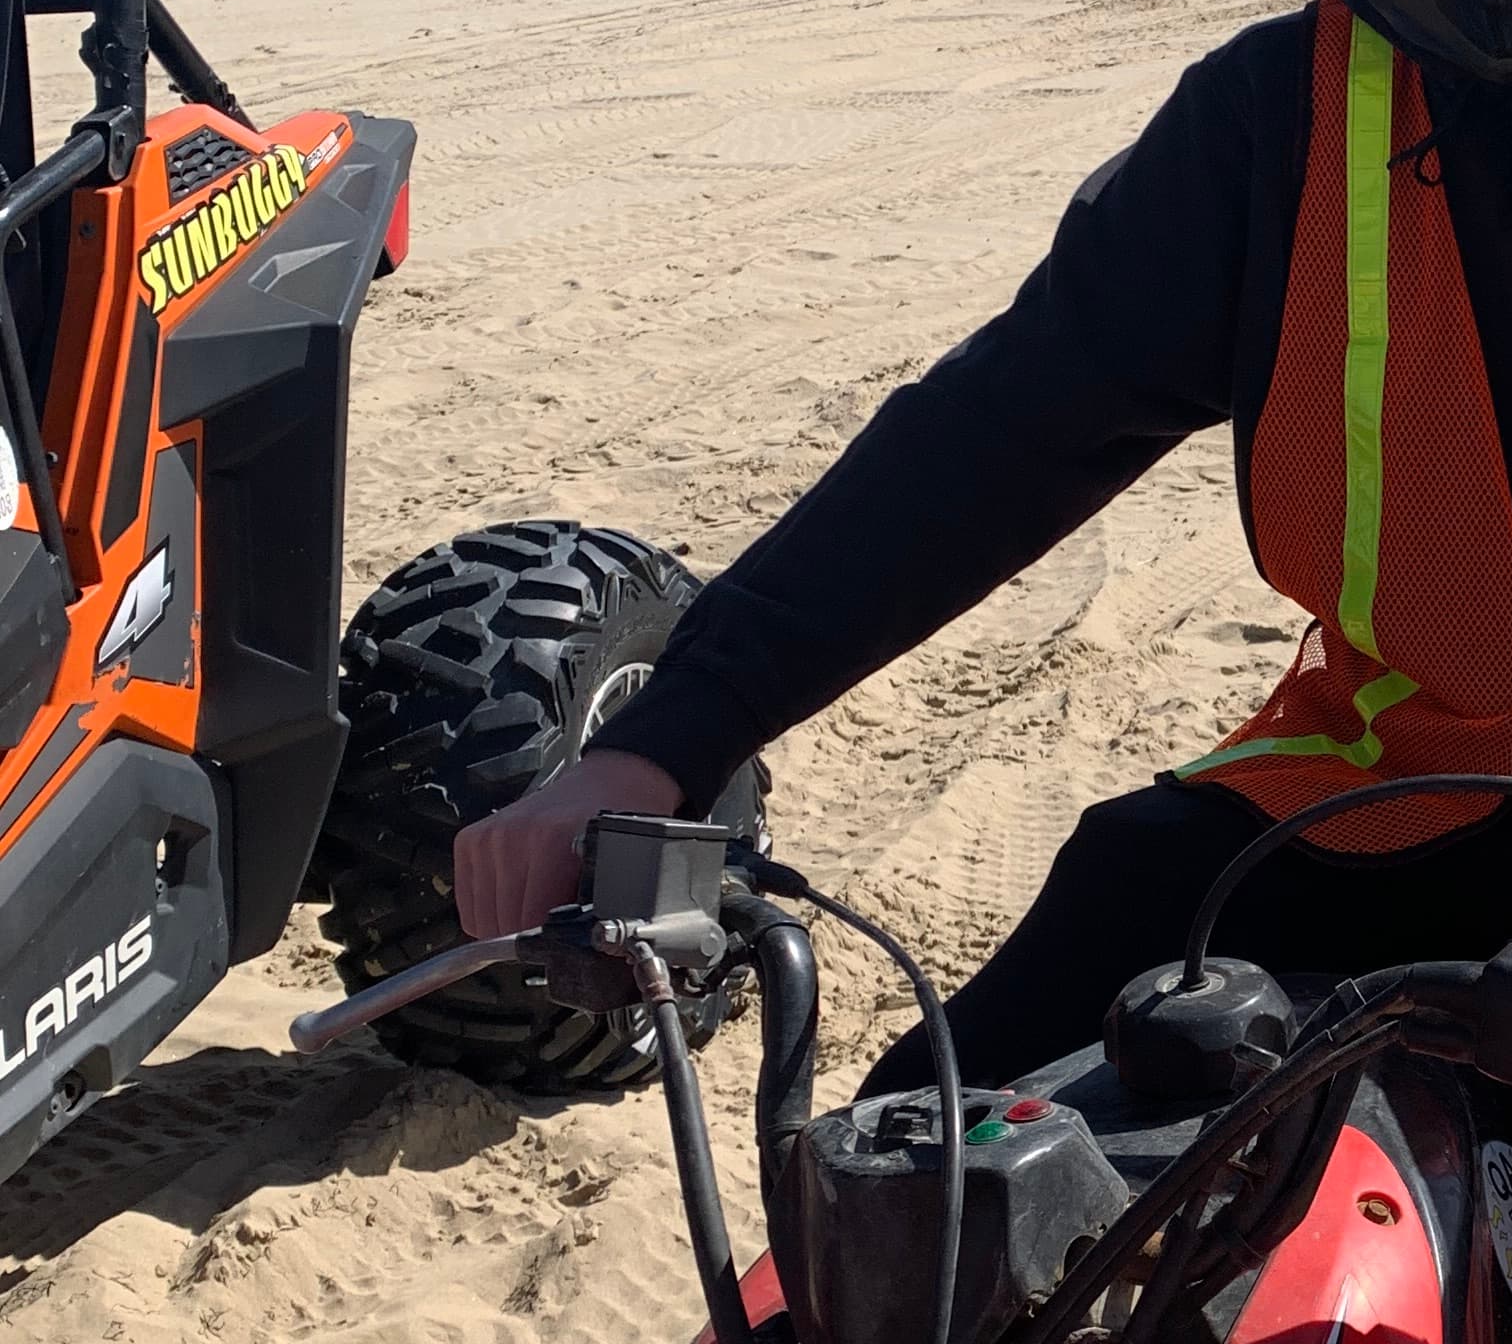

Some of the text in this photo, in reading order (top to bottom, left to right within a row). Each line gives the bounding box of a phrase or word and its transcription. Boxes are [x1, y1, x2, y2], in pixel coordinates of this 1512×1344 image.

[138, 144, 308, 315] SUNBUGGY
[99, 544, 173, 665] 4
[0, 915, 152, 1074] LARIS
